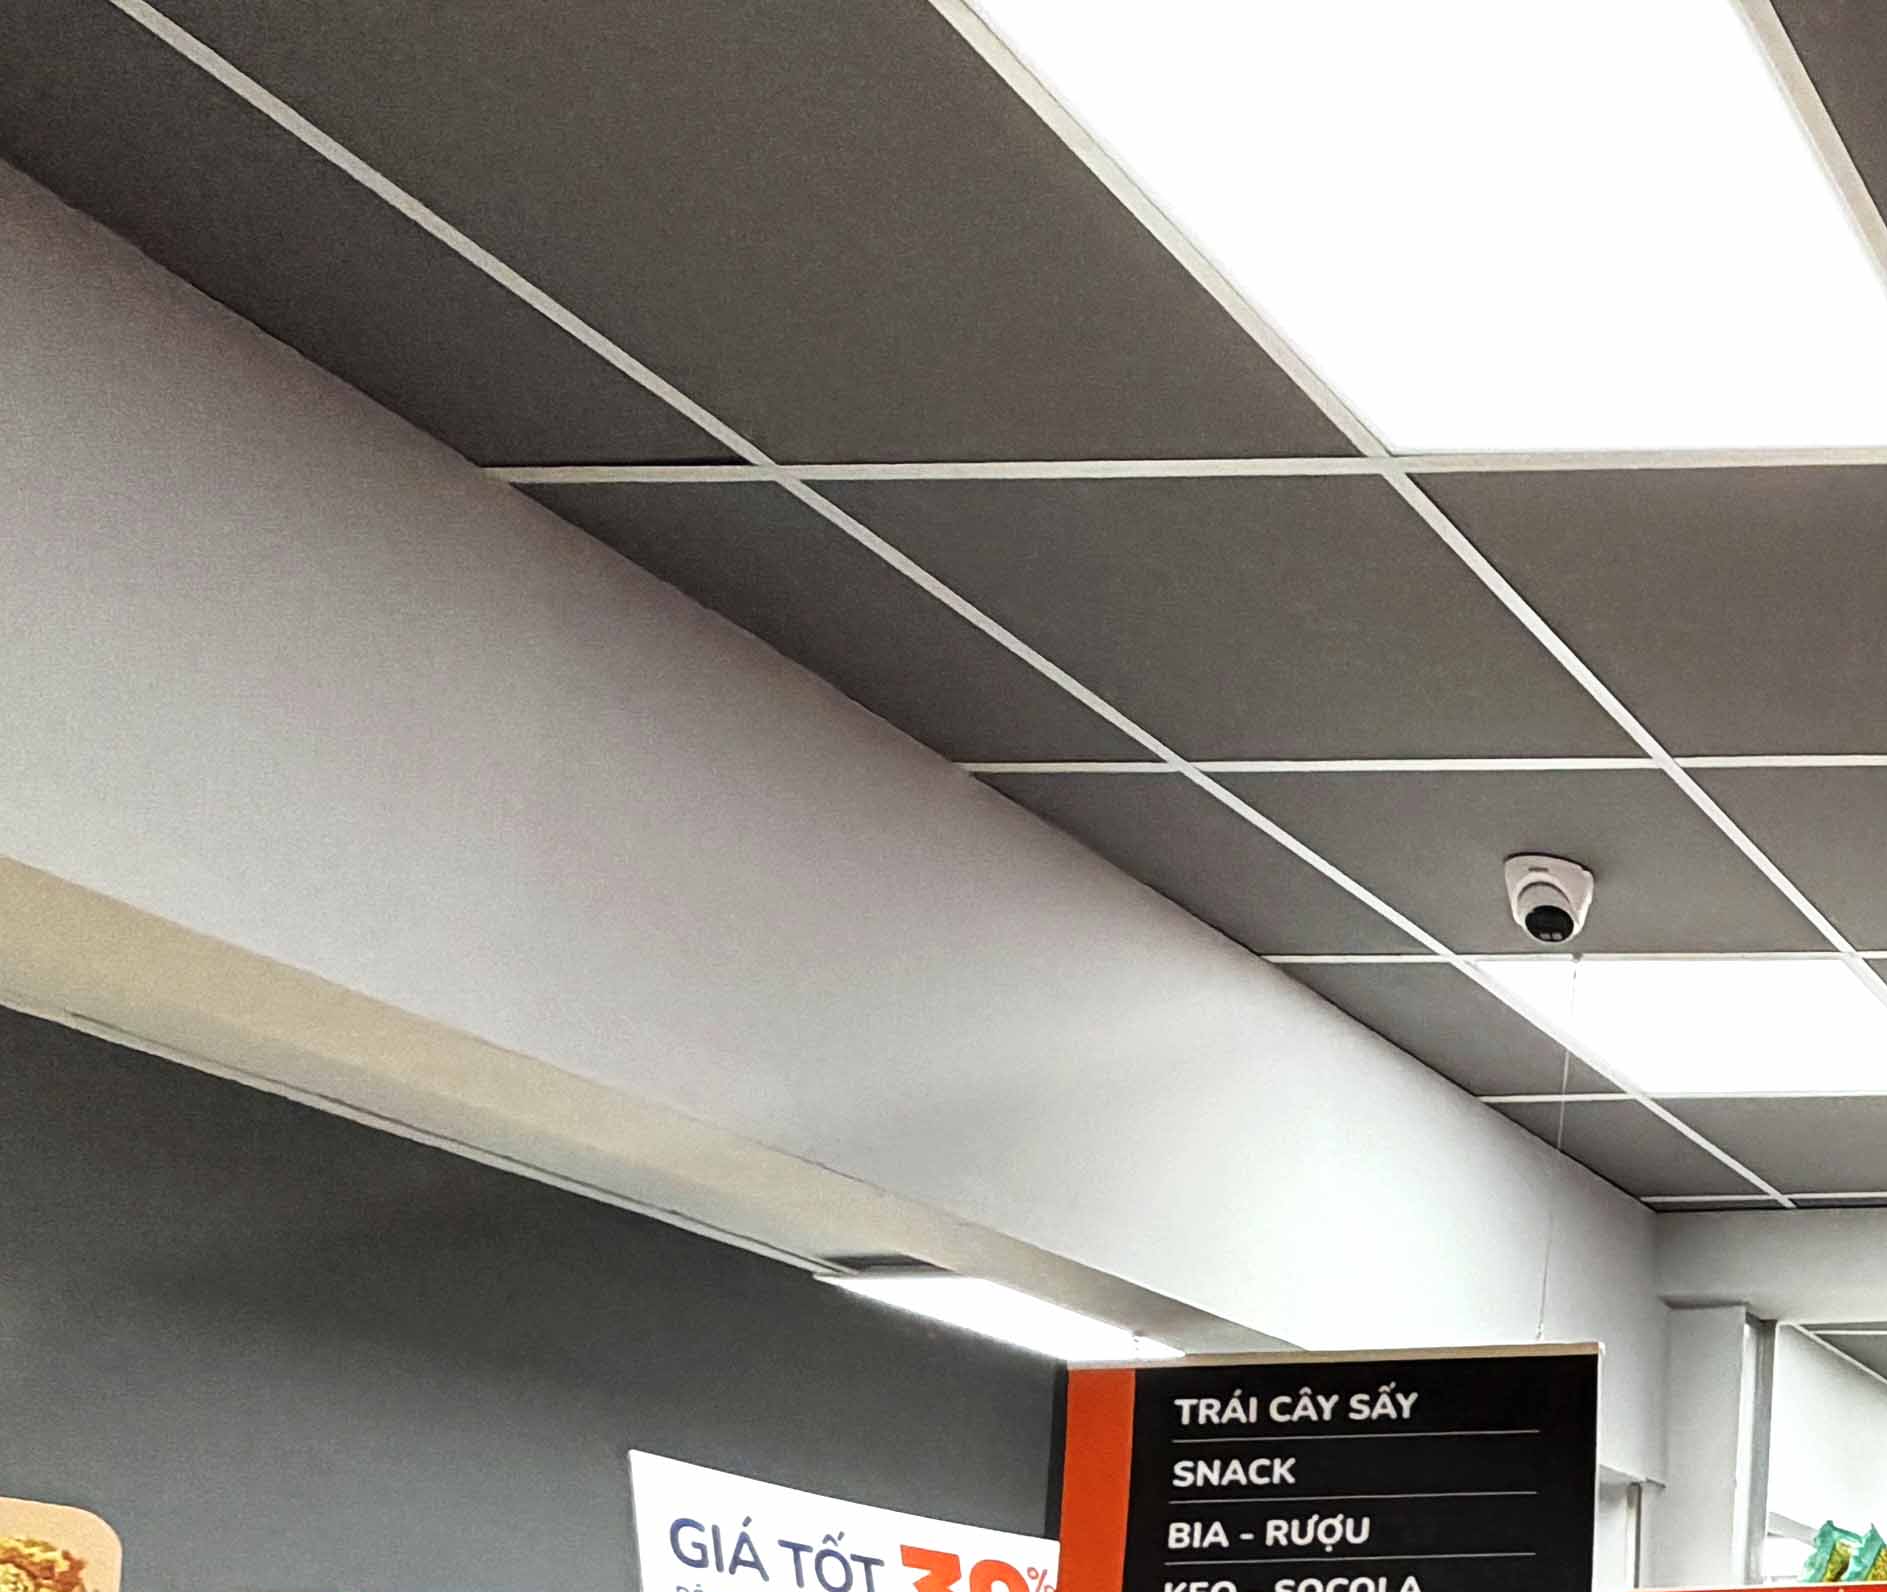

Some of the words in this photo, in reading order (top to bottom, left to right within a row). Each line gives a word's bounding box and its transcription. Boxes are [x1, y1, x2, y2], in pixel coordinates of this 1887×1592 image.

[1174, 1389, 1257, 1426] TRÁI
[1269, 1386, 1339, 1422] CÂY
[1348, 1381, 1418, 1420] SẤY
[1172, 1458, 1296, 1488] SNACK
[669, 1515, 769, 1583] GIÁ
[1167, 1521, 1229, 1550] BIA
[1266, 1515, 1370, 1554] RƯỢU
